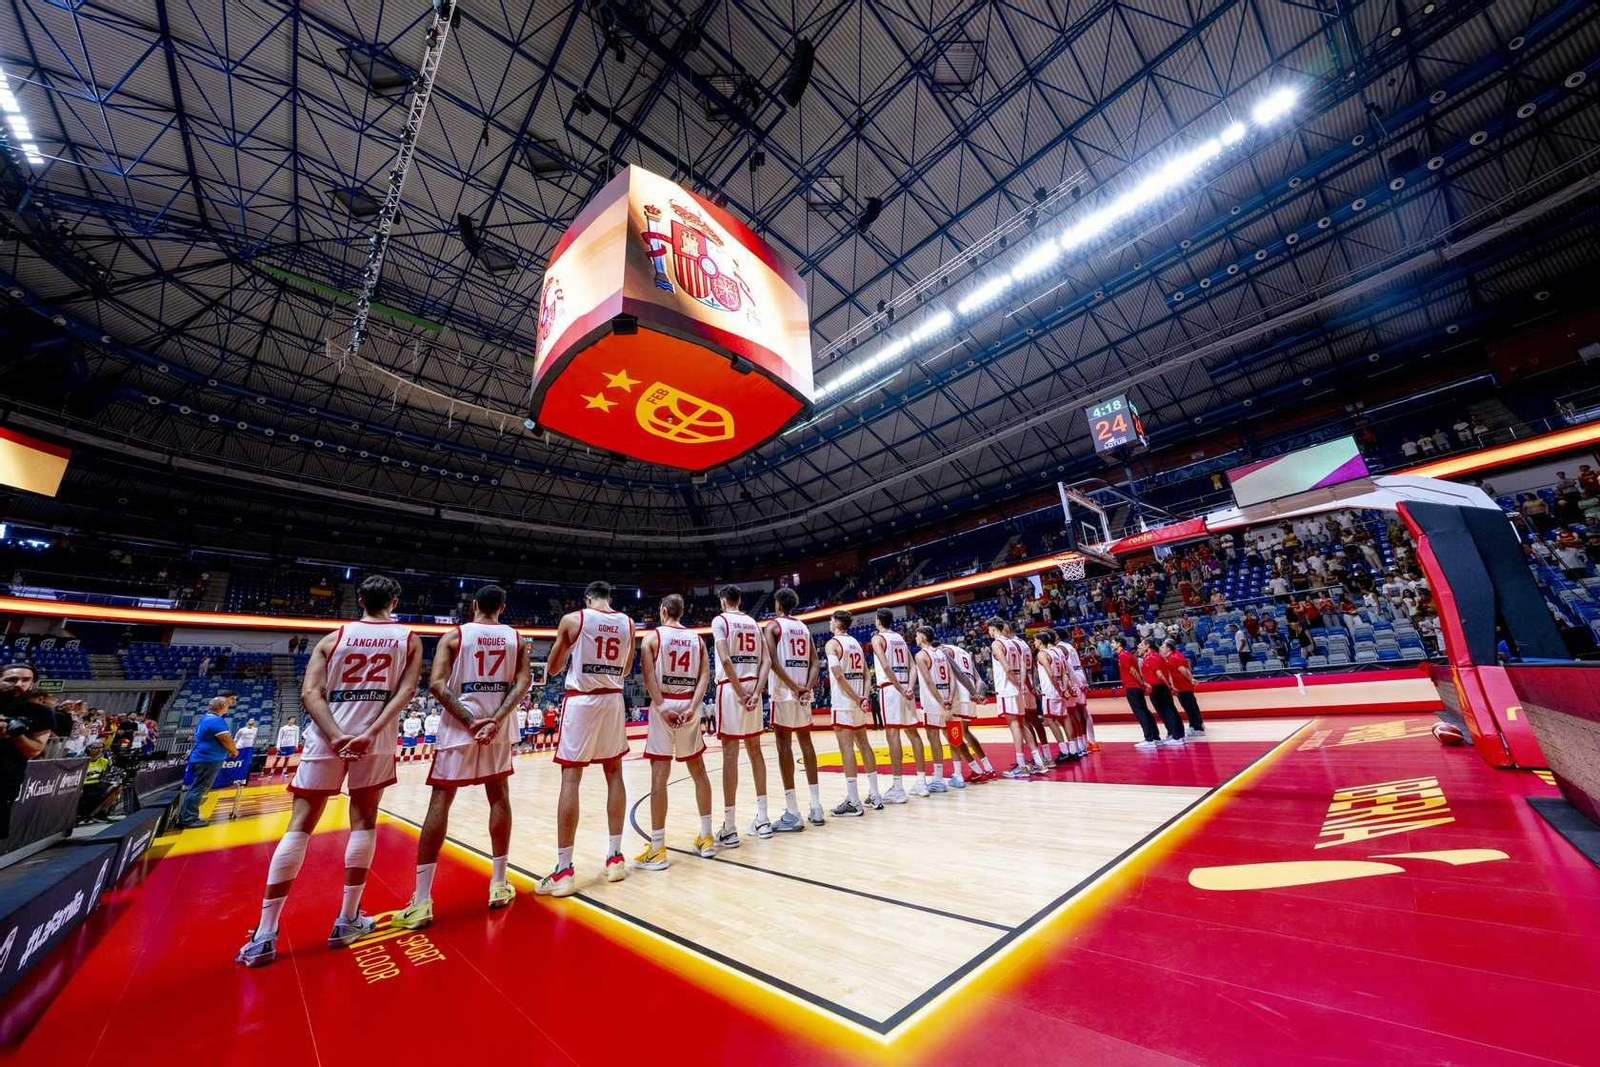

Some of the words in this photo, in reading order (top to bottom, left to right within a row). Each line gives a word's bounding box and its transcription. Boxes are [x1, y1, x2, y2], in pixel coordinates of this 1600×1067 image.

[645, 388, 669, 405] FEB
[1093, 400, 1122, 417] 4:18
[1095, 413, 1128, 442] 24
[346, 637, 399, 649] LANGARITA
[594, 635, 621, 661] 16
[737, 632, 756, 653] 15
[790, 638, 807, 657] 13
[474, 649, 507, 677] 17
[669, 650, 691, 672] 14
[849, 652, 862, 670] 12
[894, 648, 905, 664] 11
[341, 653, 393, 684] 22
[939, 665, 947, 681] 9
[221, 759, 244, 769] ten
[1313, 775, 1456, 850] IBERIA
[396, 933, 447, 967] SPORT
[352, 944, 401, 985] FLOOR
